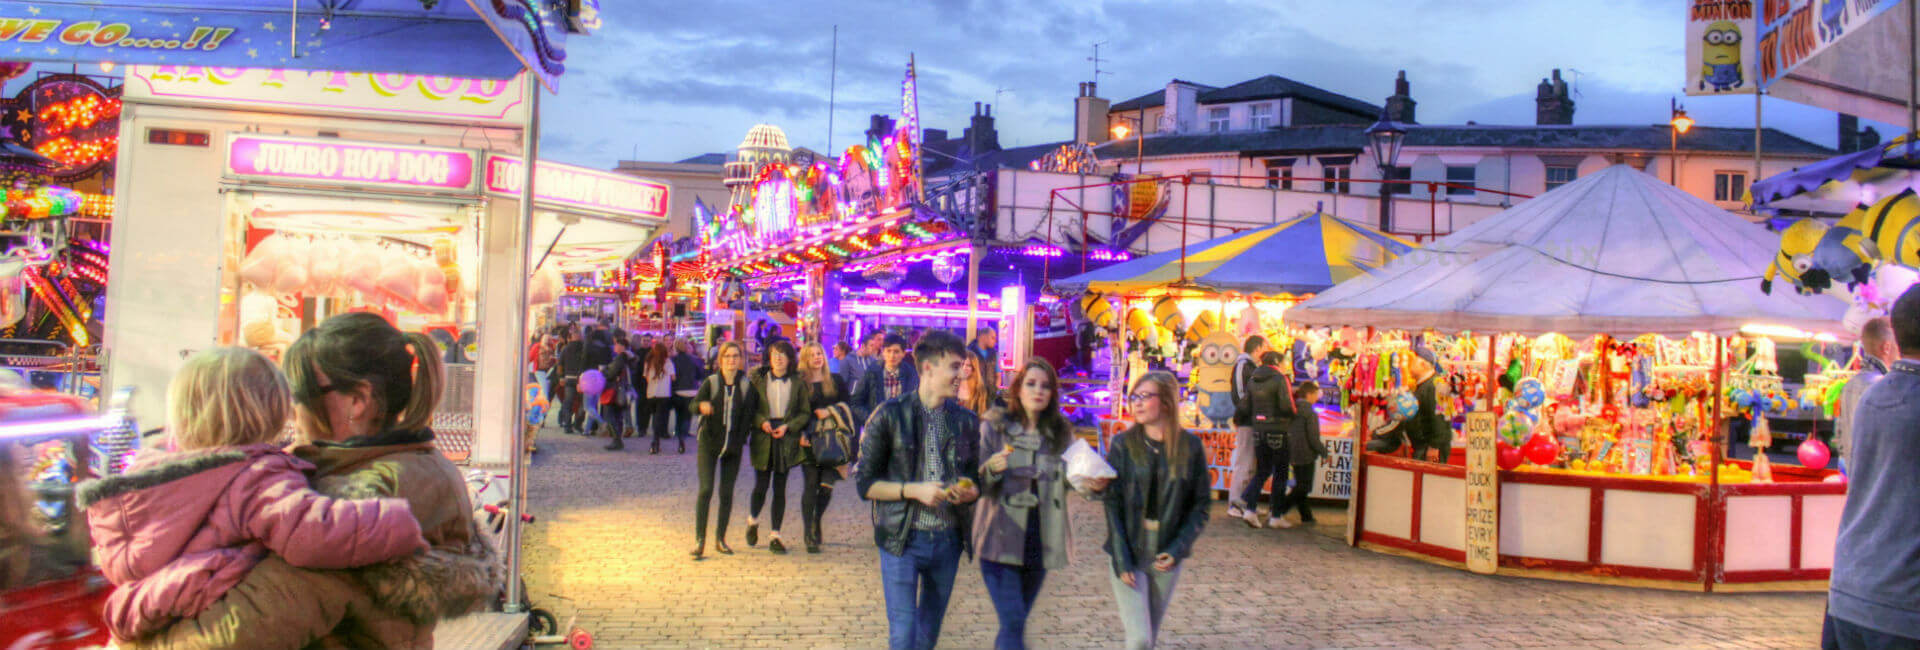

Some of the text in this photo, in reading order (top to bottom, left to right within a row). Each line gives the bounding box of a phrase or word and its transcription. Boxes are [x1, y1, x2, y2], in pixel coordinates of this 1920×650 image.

[1759, 27, 1779, 84] TO
[1780, 5, 1817, 70] WIN
[254, 142, 450, 184] JUMBO HOT DOG
[1469, 437, 1492, 450] HOOK
[1475, 453, 1484, 468] A
[1324, 471, 1352, 483] GETS
[1469, 472, 1492, 486] DUCK
[1475, 490, 1483, 504] A
[1467, 508, 1494, 525] PRIZE
